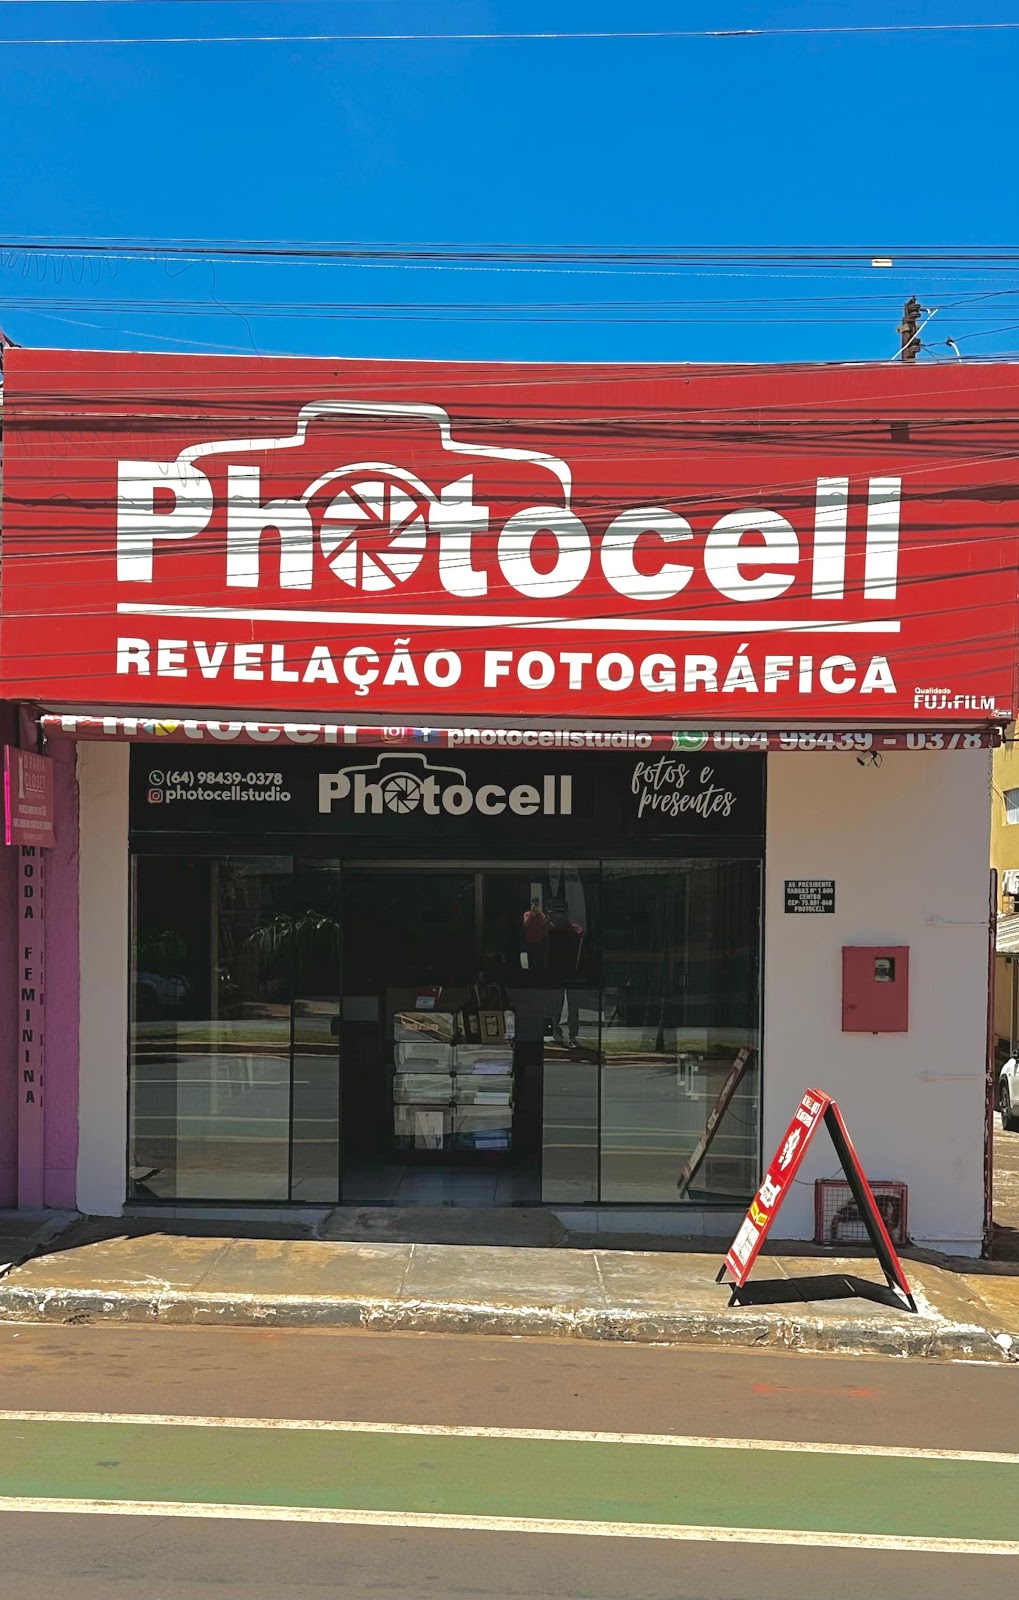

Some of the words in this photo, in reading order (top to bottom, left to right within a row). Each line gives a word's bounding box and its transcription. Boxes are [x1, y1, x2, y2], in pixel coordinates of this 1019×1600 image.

[116, 459, 904, 604] Photocell
[116, 637, 463, 697] REVELAÇÃO
[483, 643, 897, 694] FOTOGRÁFICA
[165, 785, 291, 803] photocellstudio
[166, 770, 195, 787] (64)
[197, 771, 283, 785] 98439-0378
[318, 772, 572, 815] Photocell
[631, 756, 690, 795] fotos
[699, 765, 715, 784] e
[637, 783, 737, 819] presentes
[21, 946, 36, 1104] FEMININA
